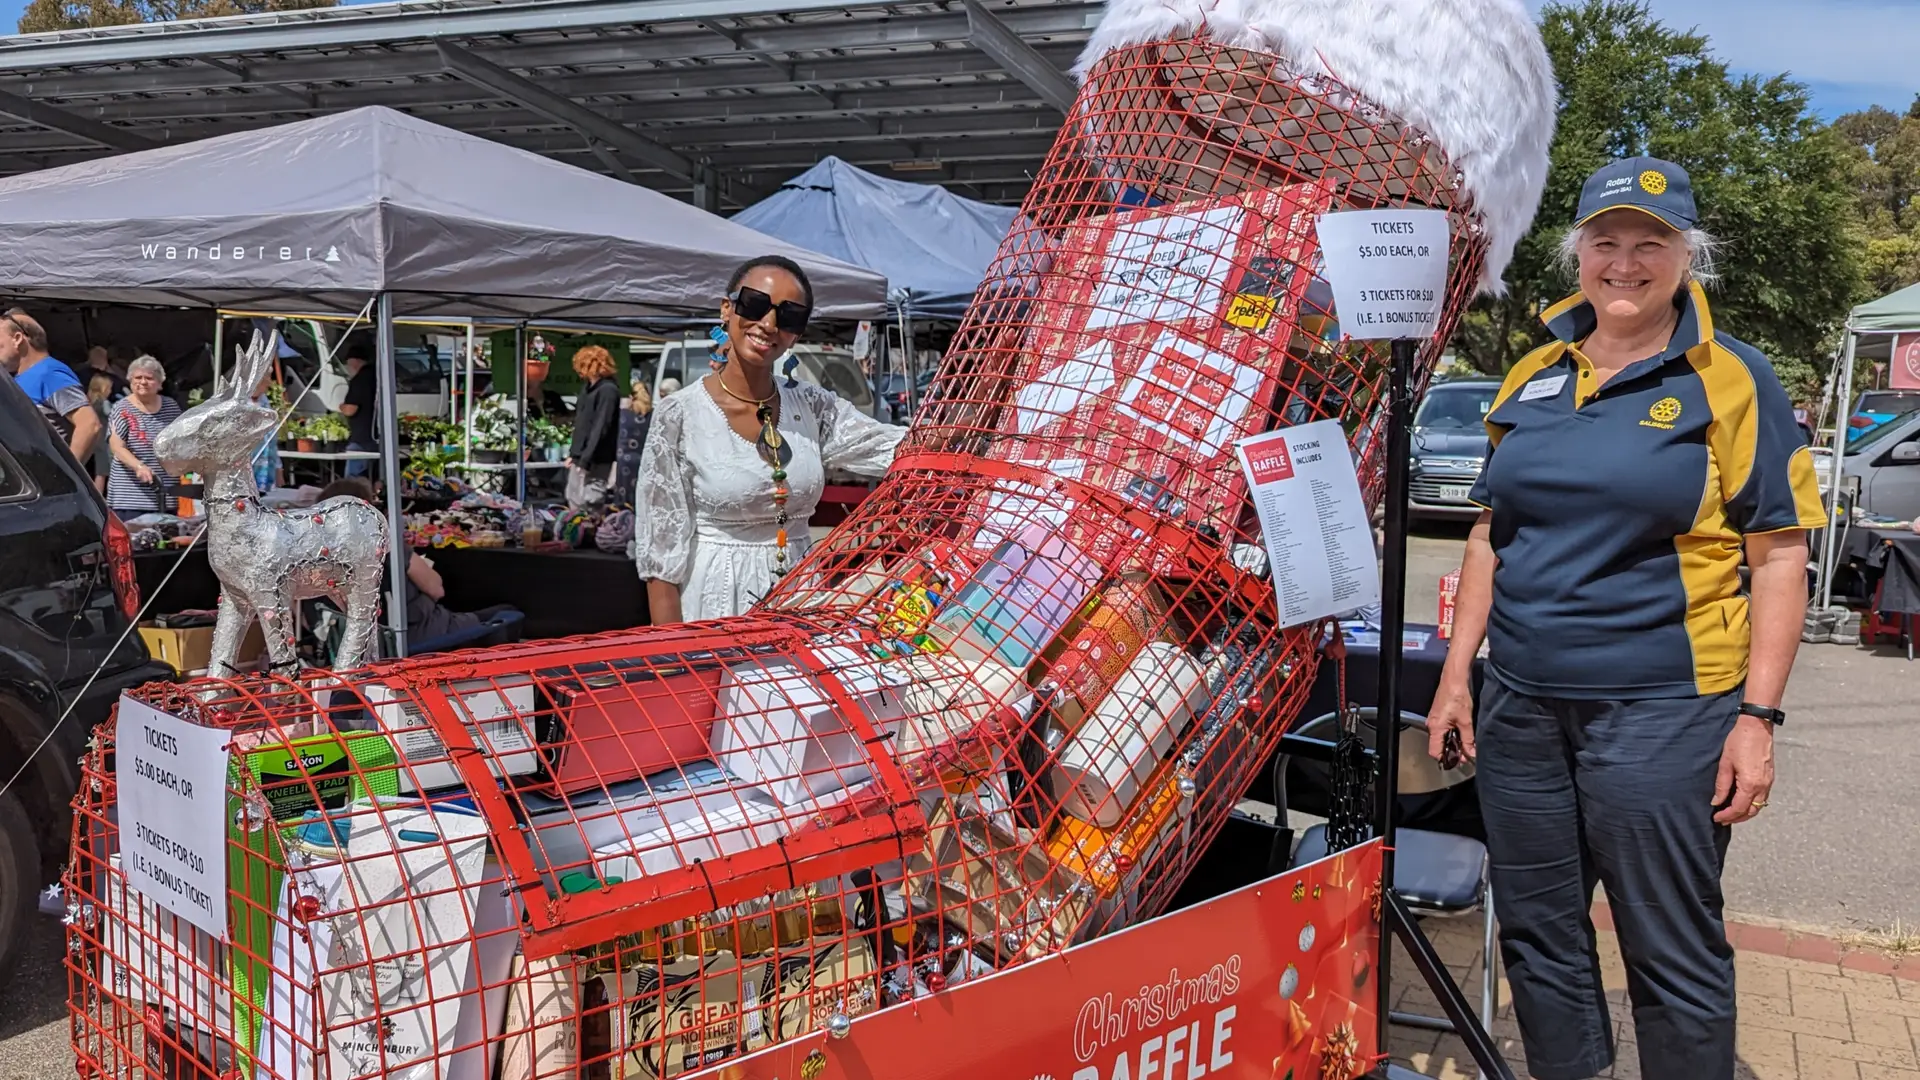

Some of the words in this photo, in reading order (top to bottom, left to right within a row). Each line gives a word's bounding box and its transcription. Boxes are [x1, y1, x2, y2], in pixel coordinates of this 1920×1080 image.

[1606, 177, 1633, 188] Rotary
[1371, 222, 1414, 234] TICKETS
[141, 243, 312, 261] Wanderer
[1359, 245, 1387, 258] $5.00
[1390, 246, 1417, 258] EACH,
[1418, 246, 1429, 257] OR
[1114, 293, 1141, 304] Vaue
[1360, 291, 1367, 302] 3
[1369, 290, 1405, 301] TICKETS
[1407, 290, 1421, 301] FOR
[1422, 289, 1434, 302] $10
[1357, 313, 1377, 326] (I.E.
[1379, 313, 1383, 324] 1
[1387, 312, 1413, 324] BONUS
[1160, 357, 1190, 377] coles
[1177, 407, 1207, 430] coles
[1293, 440, 1320, 452] STOCKING
[1253, 455, 1287, 473] RAFFLE
[1296, 453, 1322, 465] INCLUDES
[144, 725, 177, 756] TICKETS
[135, 755, 155, 782] $5.00
[156, 768, 180, 796] EACH,
[181, 779, 193, 799] OR
[324, 777, 345, 788] PAD
[136, 821, 141, 838] 3
[141, 825, 171, 856] TICKETS
[173, 842, 188, 864] FOR
[190, 849, 204, 874] $10
[132, 851, 147, 874] (I.E.
[148, 861, 154, 879] 1
[154, 864, 182, 895] BONUS
[183, 880, 213, 918] TICKET)
[809, 980, 865, 1007] GREA
[680, 1001, 738, 1029] GREAT
[811, 995, 872, 1020] NORERN
[1074, 954, 1241, 1063] Christmas
[342, 1041, 420, 1055] MINCHNBURY
[1072, 1005, 1237, 1080] FFLE
[686, 1056, 705, 1069] SUPE
[706, 1051, 724, 1063] CRISP
